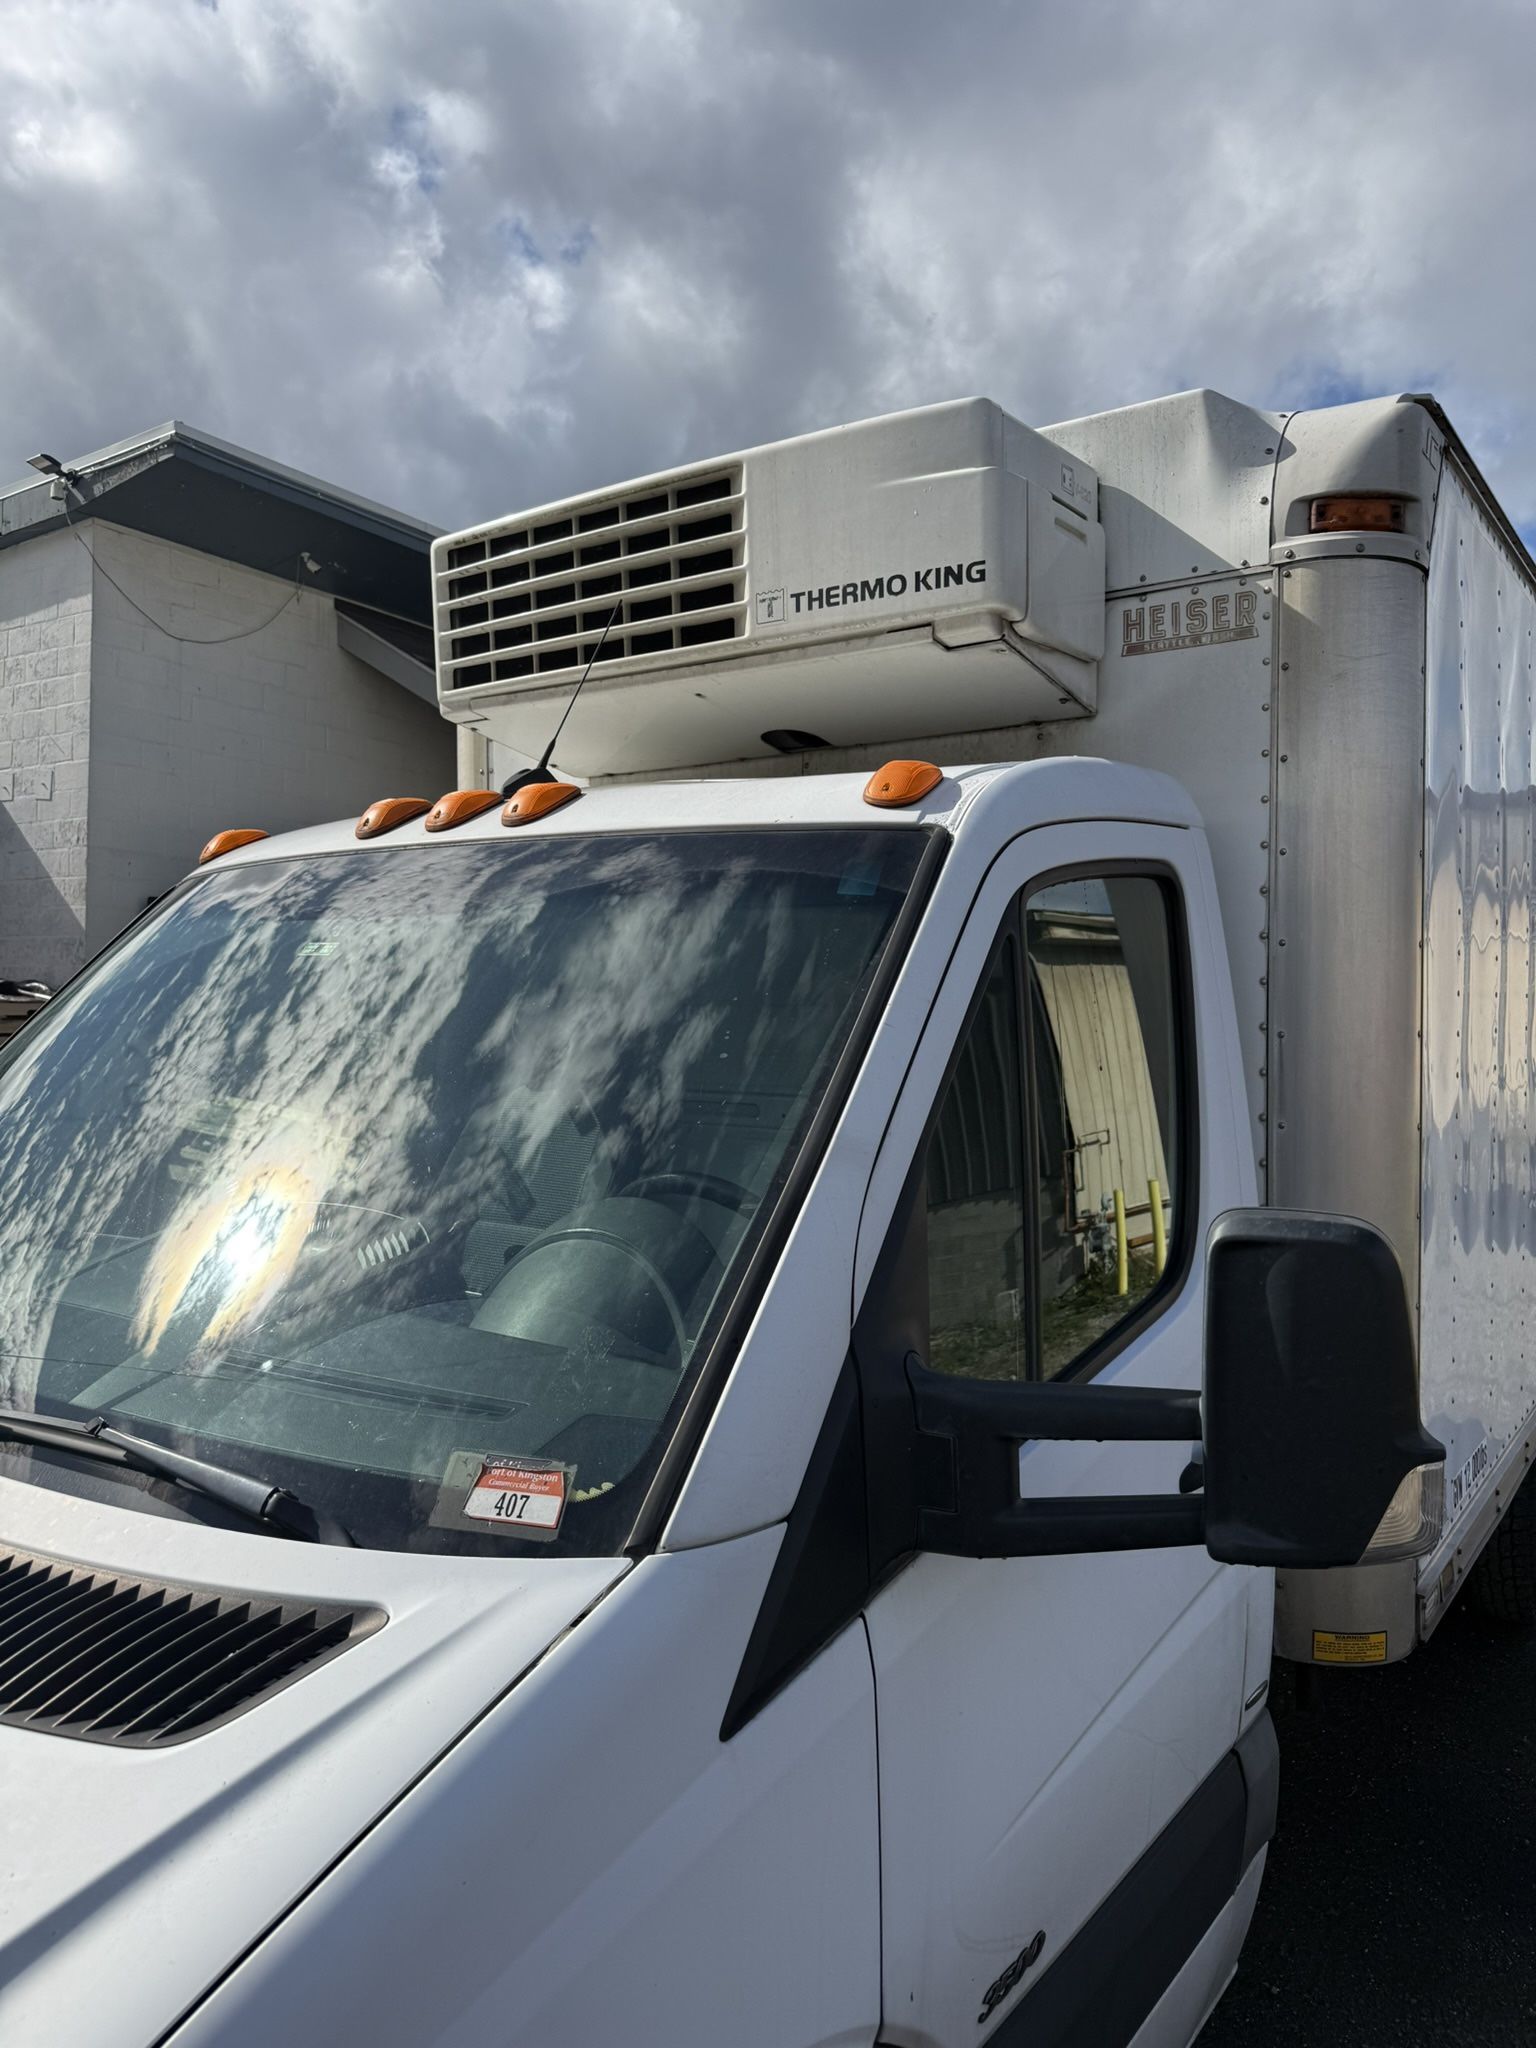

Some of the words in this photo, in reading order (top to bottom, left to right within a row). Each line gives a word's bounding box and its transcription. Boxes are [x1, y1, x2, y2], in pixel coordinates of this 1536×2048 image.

[790, 574, 907, 613] THERMO
[914, 559, 986, 592] KING
[1123, 591, 1257, 643] HEISER
[488, 1478, 529, 1489] Commercial
[528, 1482, 550, 1492] Buyer
[518, 1470, 558, 1482] Kingston
[494, 1492, 531, 1519] 407
